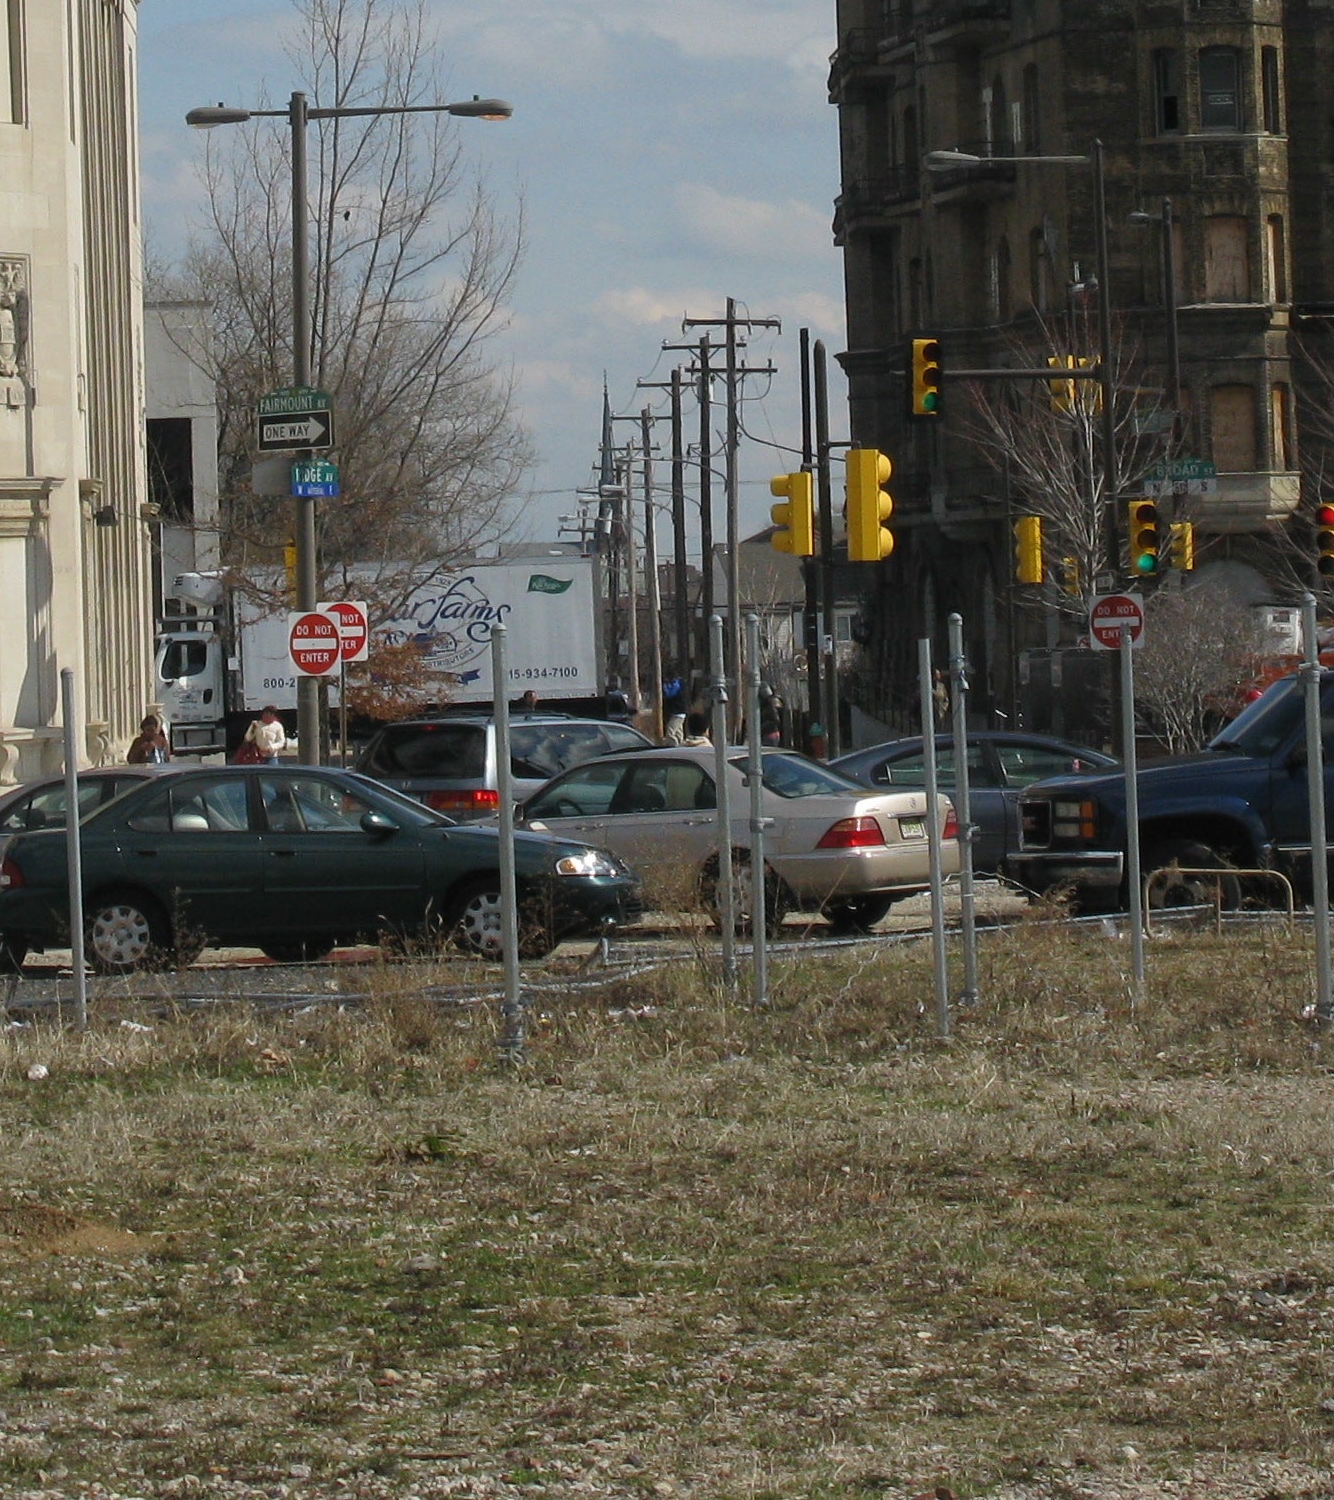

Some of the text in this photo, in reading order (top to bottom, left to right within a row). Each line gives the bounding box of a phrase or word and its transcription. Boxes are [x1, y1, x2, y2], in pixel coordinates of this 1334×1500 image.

[259, 396, 313, 412] FAIRMOUNT
[265, 424, 310, 439] ONE WAY
[1097, 605, 1135, 616] DO NOT
[341, 614, 359, 624] NOT
[296, 625, 332, 636] DO NOT
[340, 640, 357, 650] TER
[300, 652, 330, 663] ENTER
[508, 666, 578, 681] 15-934-7100
